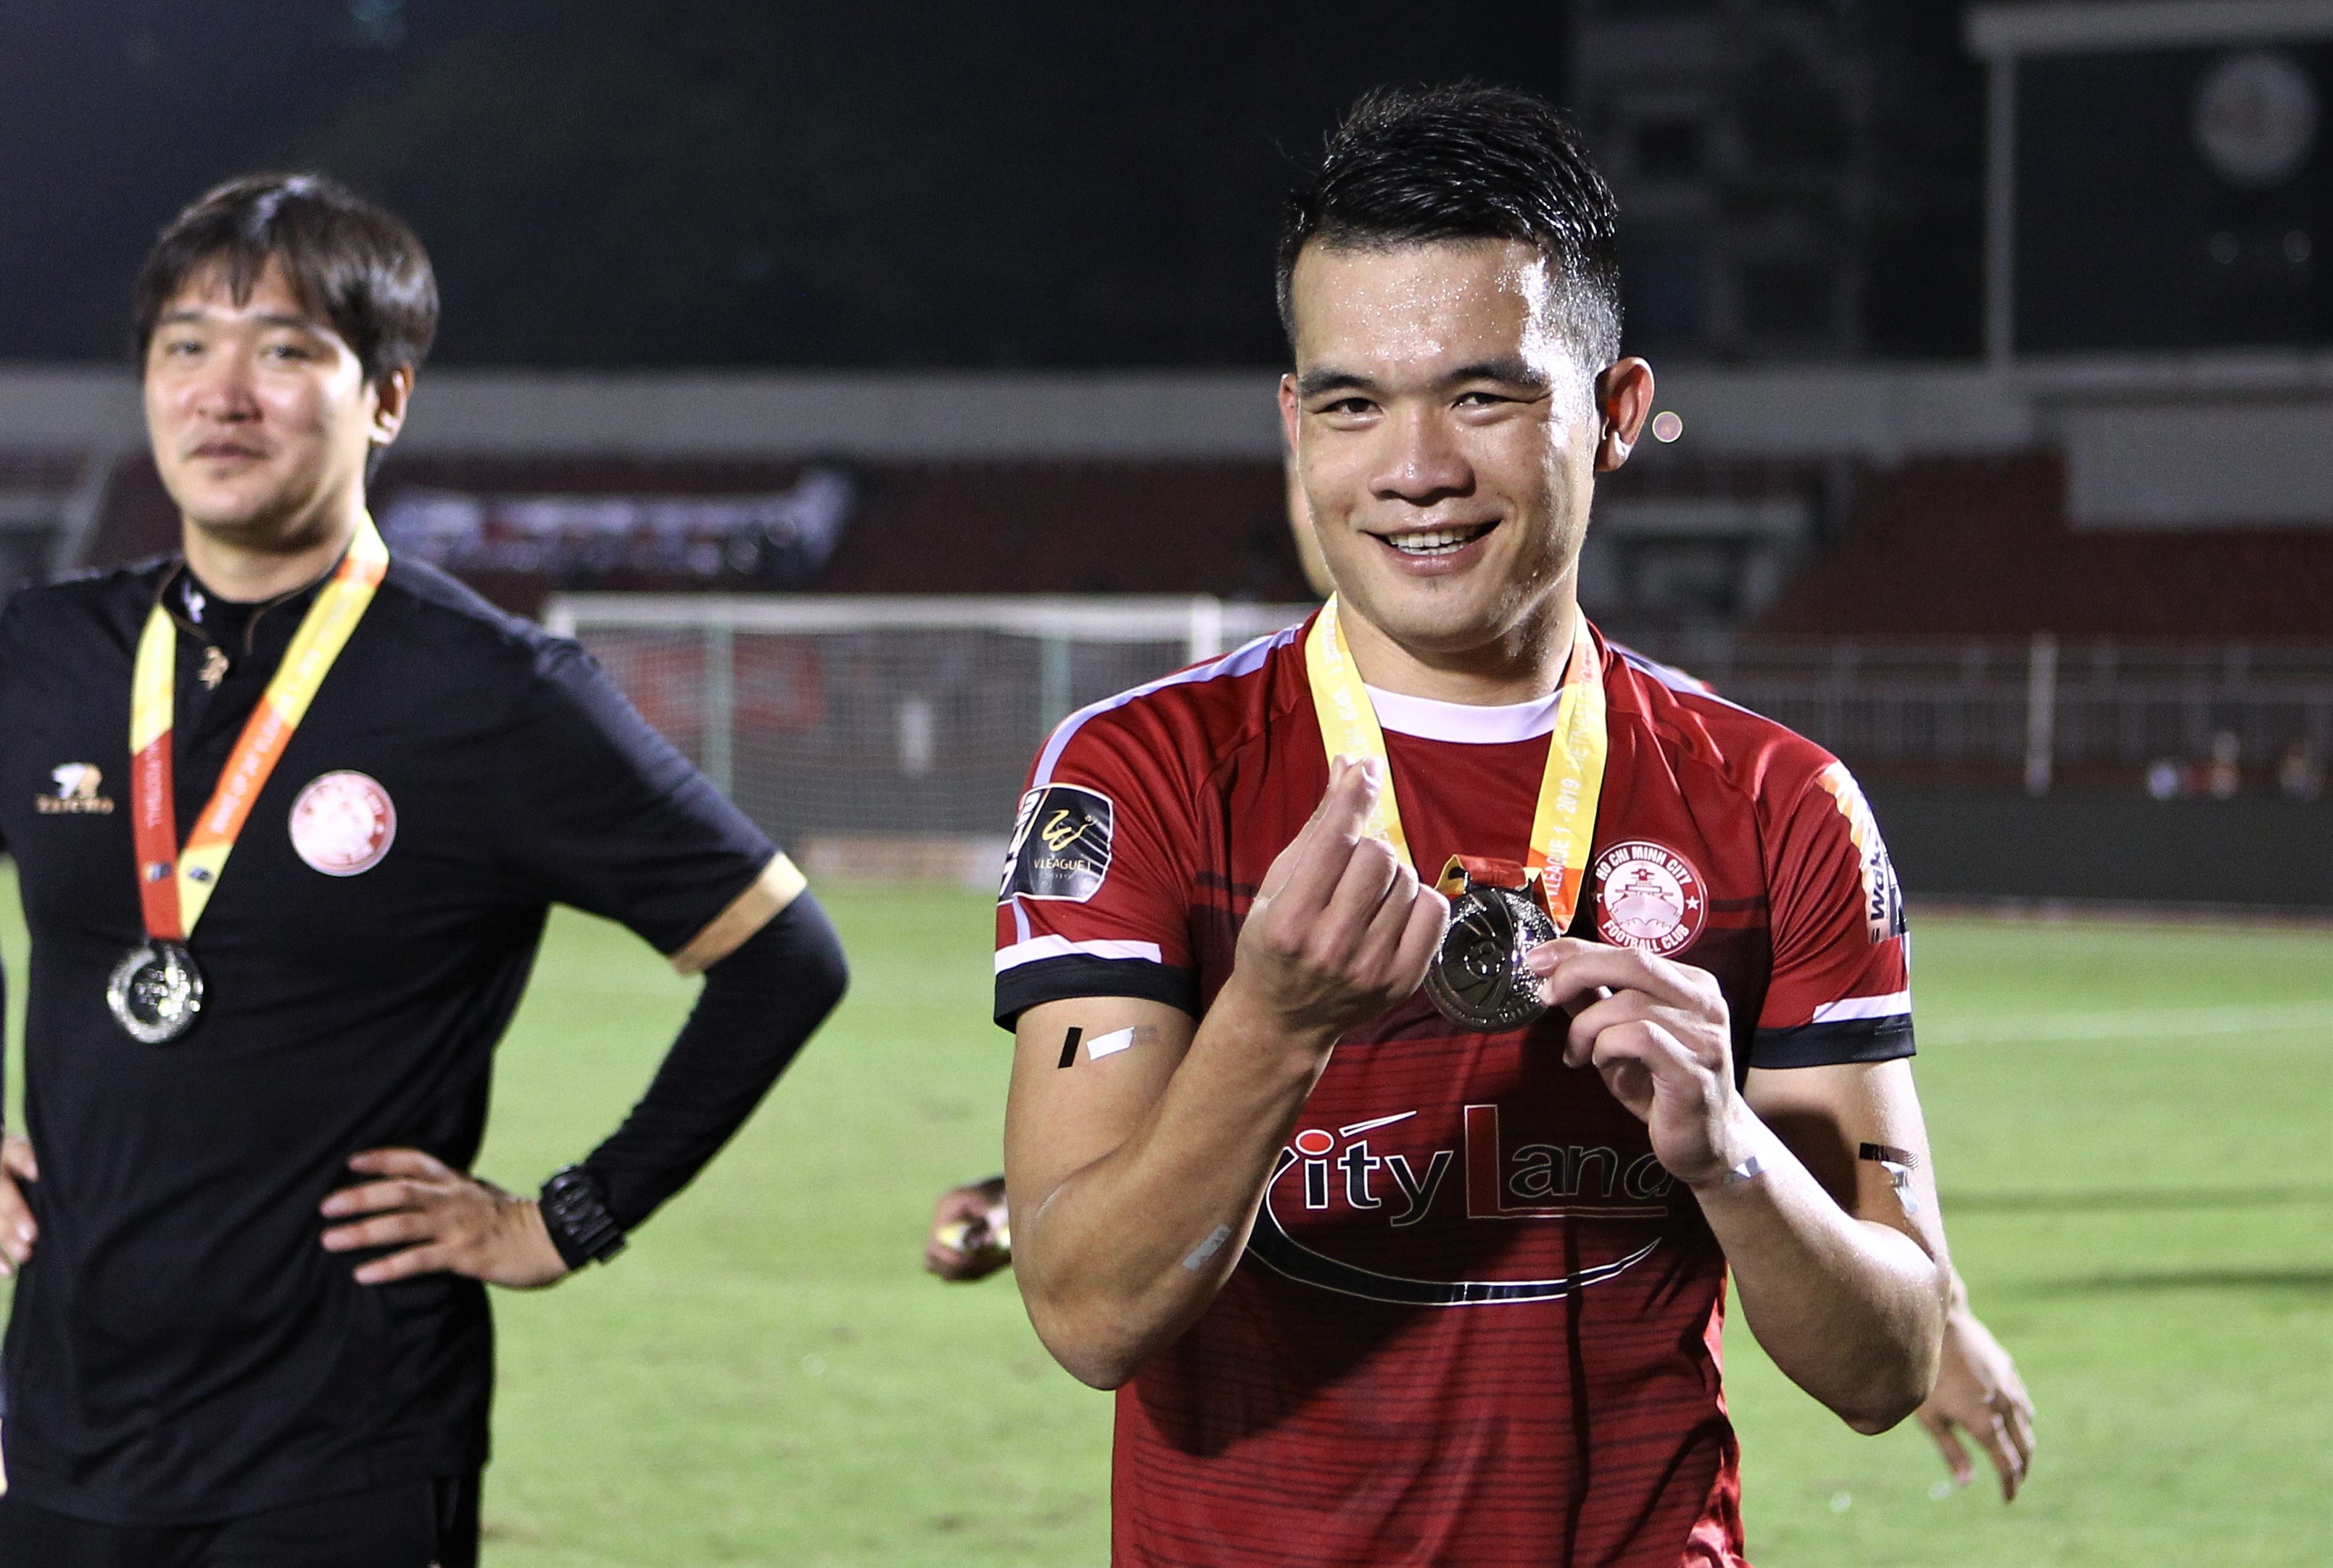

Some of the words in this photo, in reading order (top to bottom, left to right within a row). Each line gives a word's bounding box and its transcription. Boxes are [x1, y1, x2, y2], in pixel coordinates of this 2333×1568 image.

[1556, 777, 1580, 814] 2019
[1552, 825, 1570, 834] 1
[1543, 838, 1570, 901] V.LEAGUE
[1595, 861, 1610, 881] HO
[1609, 847, 1630, 868] CHI
[1631, 846, 1667, 865] MINH
[1666, 859, 1693, 886] CITY
[1602, 920, 1661, 952] FOOTBALL
[1661, 923, 1690, 949] CLUB
